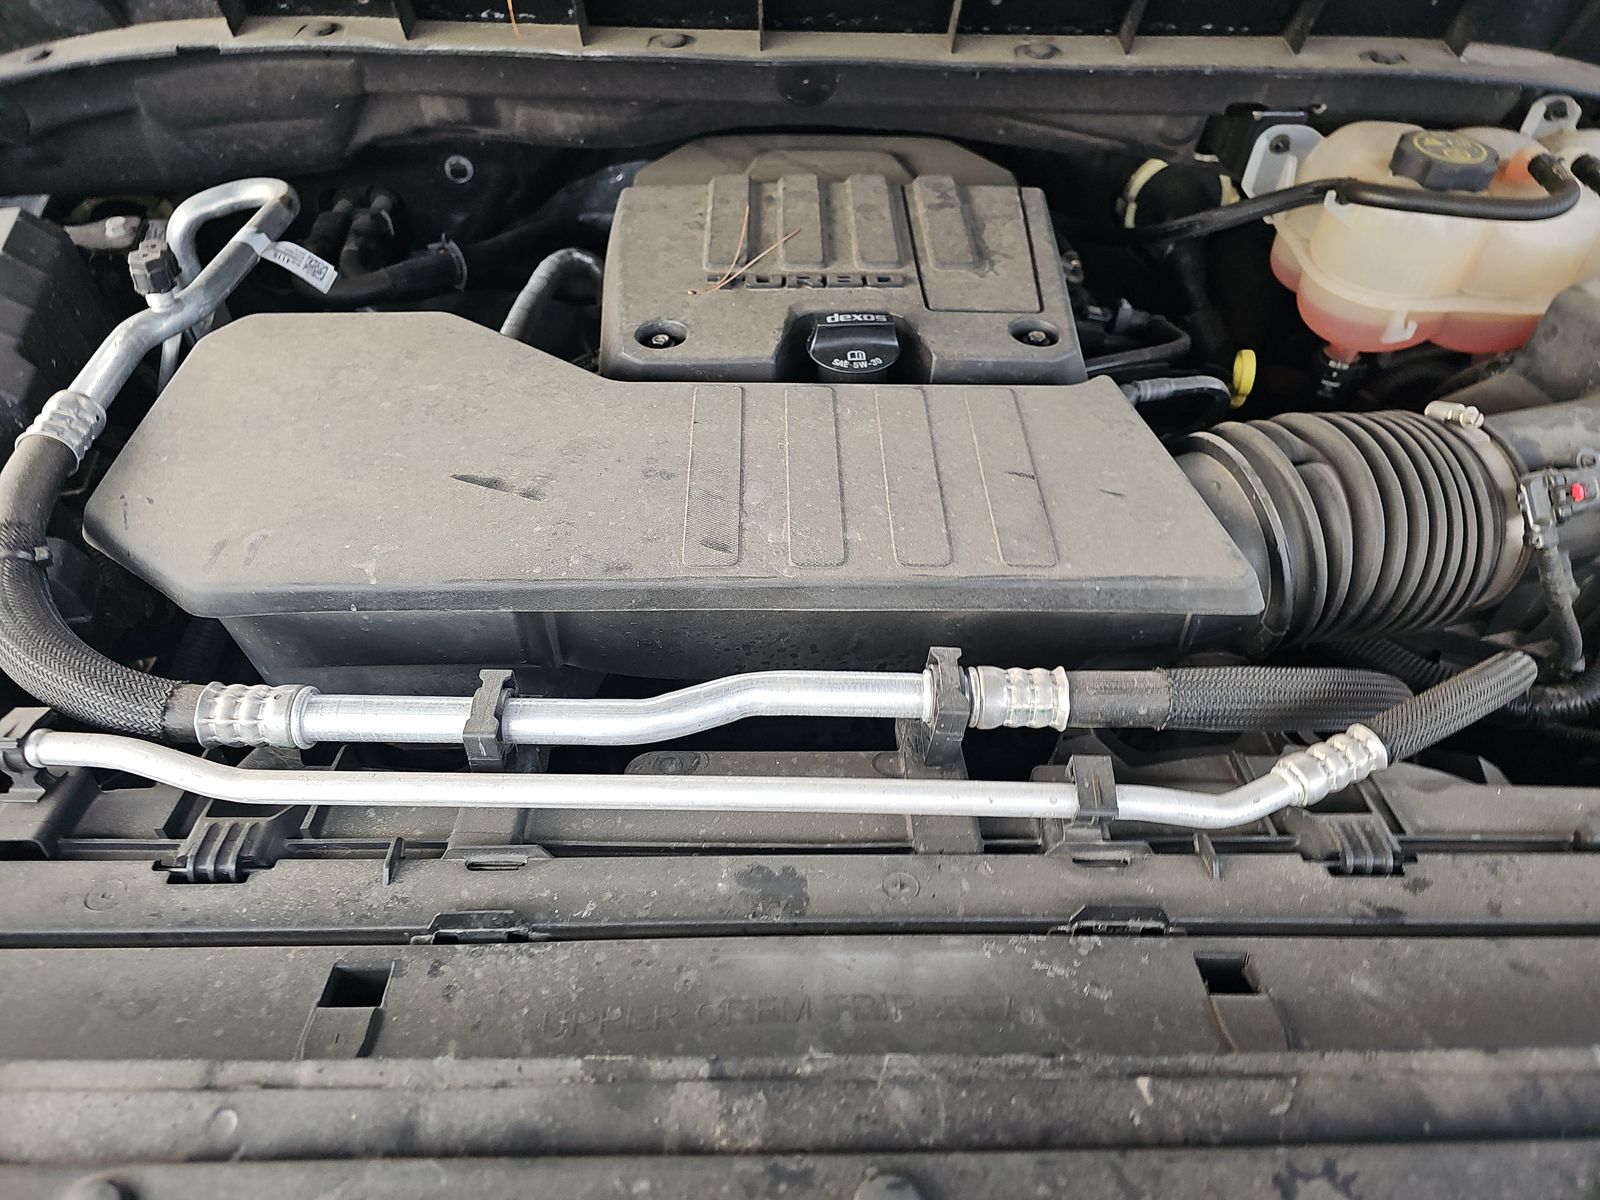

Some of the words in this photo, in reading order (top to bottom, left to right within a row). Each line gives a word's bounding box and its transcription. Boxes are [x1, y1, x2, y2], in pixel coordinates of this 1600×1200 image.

[826, 313, 887, 323] dexos
[832, 358, 850, 368] SAE
[852, 357, 883, 369] 5W-30
